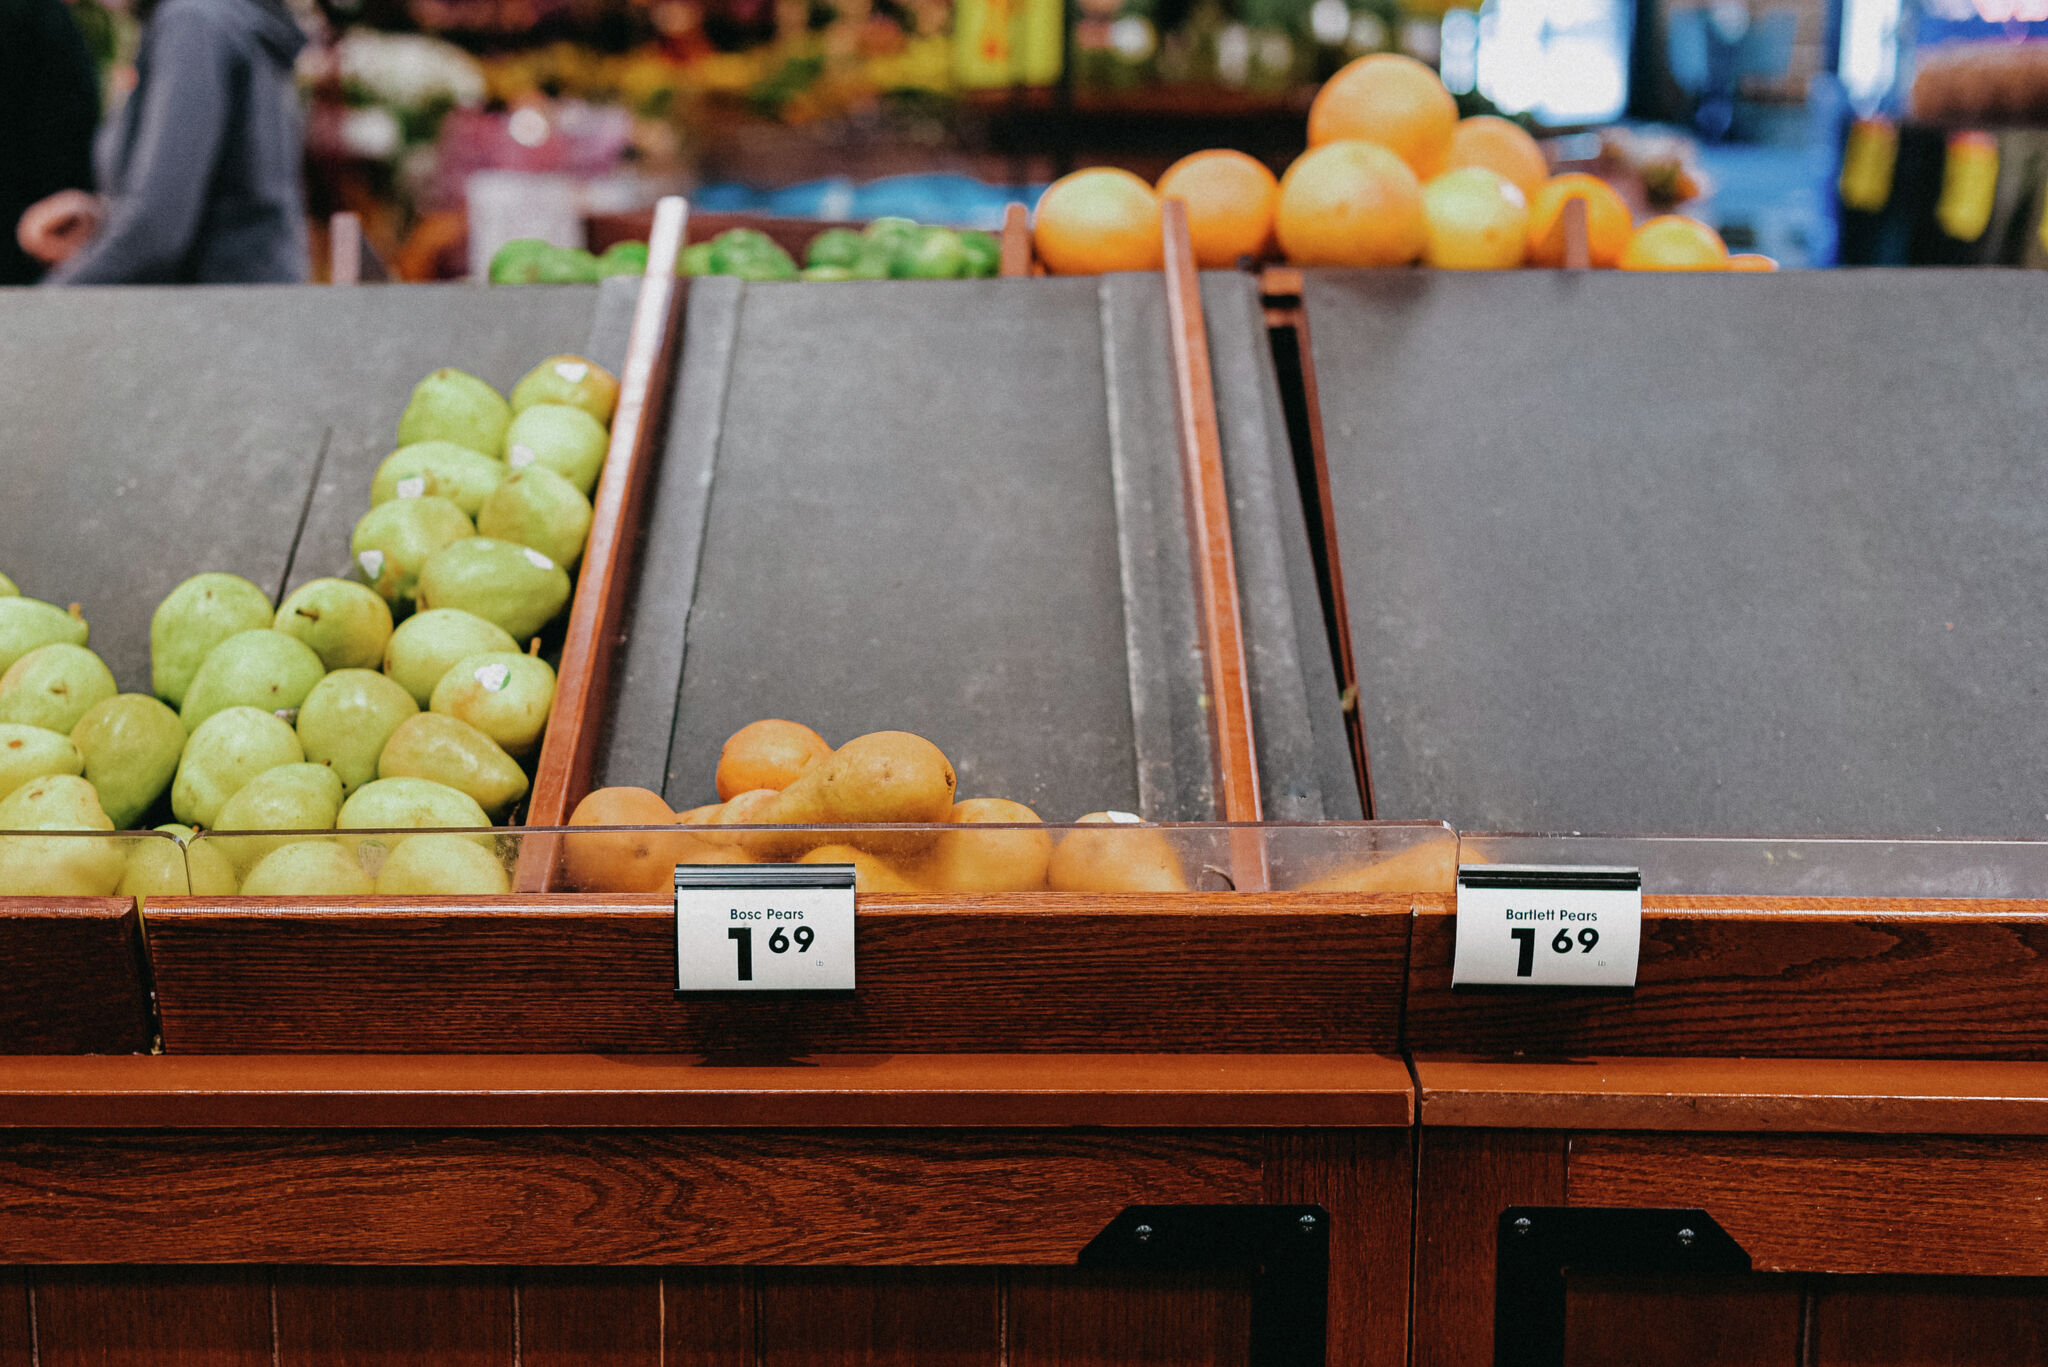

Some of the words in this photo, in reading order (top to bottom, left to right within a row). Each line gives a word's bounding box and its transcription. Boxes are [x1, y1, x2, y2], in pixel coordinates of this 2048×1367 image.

[730, 908, 762, 920] Bosc
[766, 908, 804, 920] Pears
[1506, 908, 1555, 921] Bartlett
[1559, 909, 1598, 921] Pears
